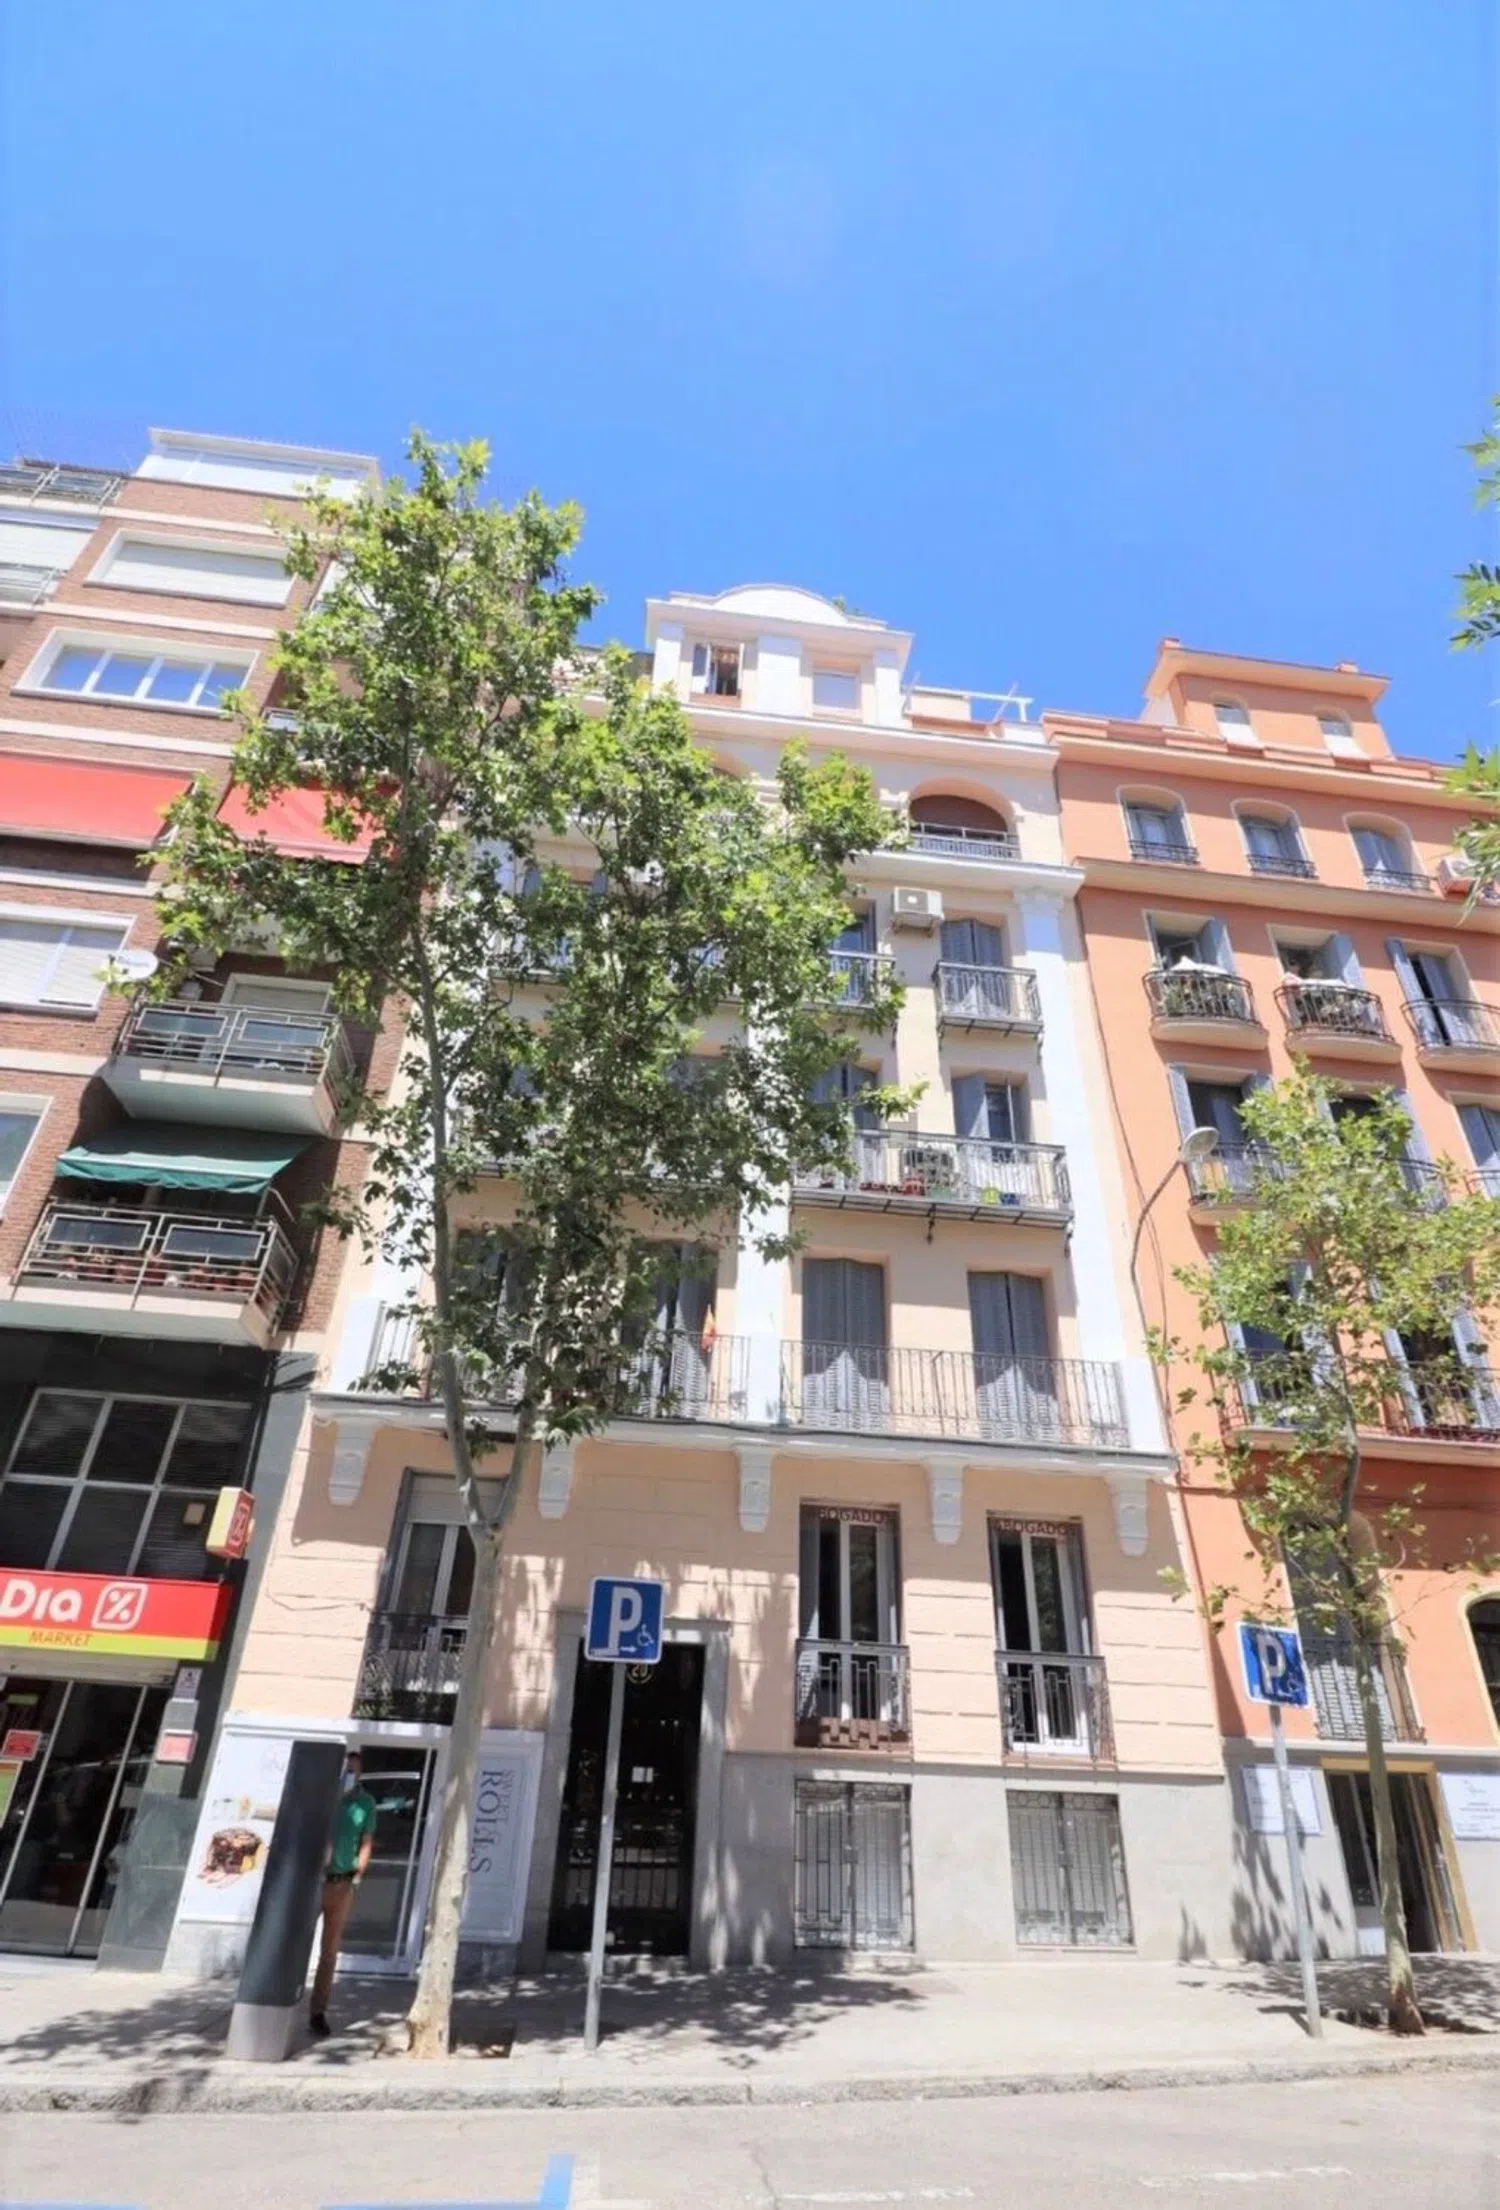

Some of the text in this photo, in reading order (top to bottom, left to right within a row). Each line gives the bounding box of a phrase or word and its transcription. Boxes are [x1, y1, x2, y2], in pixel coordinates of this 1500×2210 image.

[29, 1631, 93, 1647] MARKET
[608, 1586, 643, 1656] P
[1256, 1632, 1287, 1695] P
[468, 1770, 503, 1874] ROLLS
